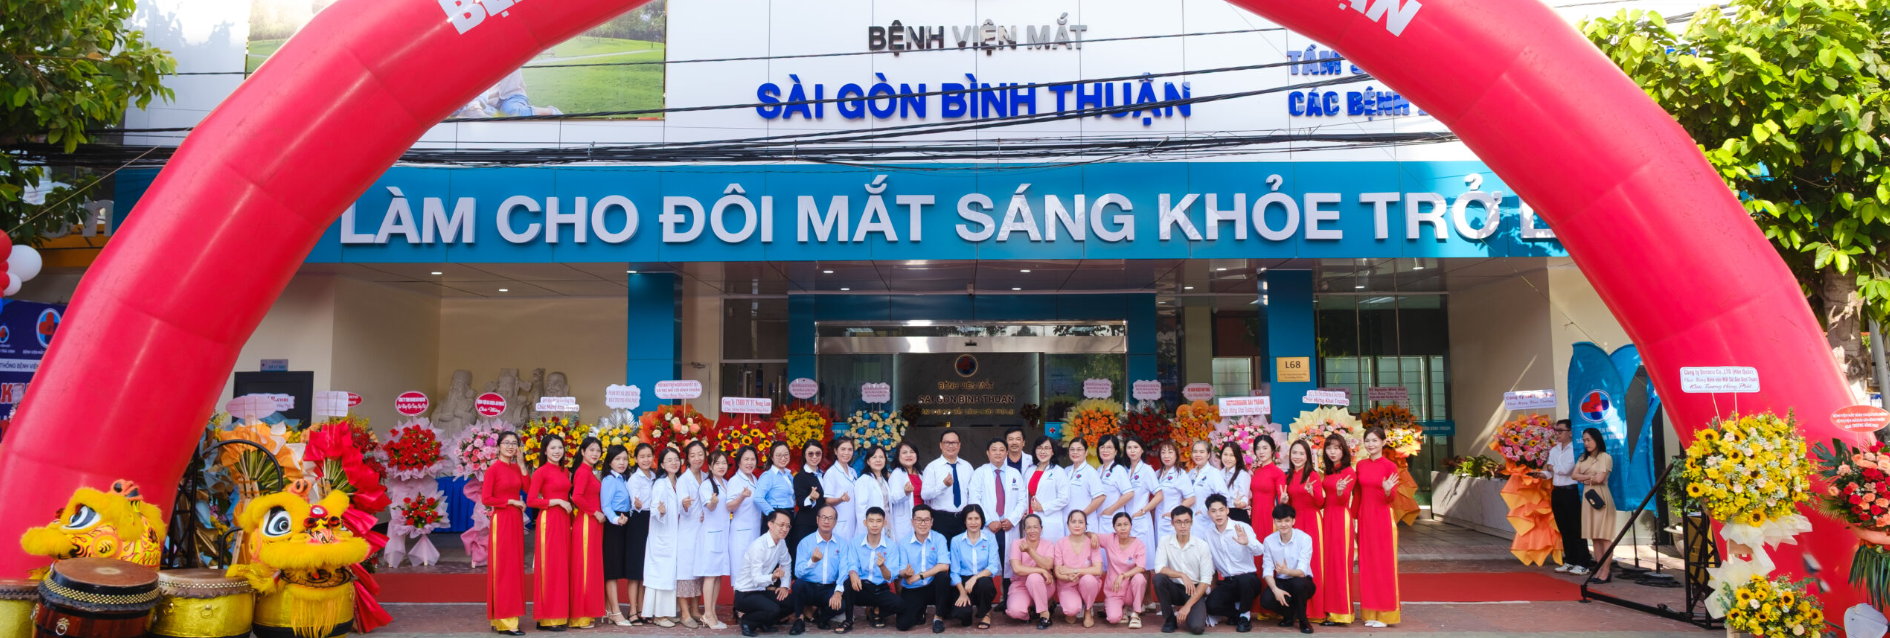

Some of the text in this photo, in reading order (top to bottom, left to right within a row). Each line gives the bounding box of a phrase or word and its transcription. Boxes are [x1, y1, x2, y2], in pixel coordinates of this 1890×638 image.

[868, 12, 1088, 57] BỆNH VIỆN MẮT
[756, 72, 1192, 126] SÀI GÒN BÌNH THUẬN
[1288, 86, 1410, 121] CÁC BỆNH
[340, 186, 476, 244] LÀM
[496, 194, 640, 244] CHO
[658, 183, 774, 243] ĐÔI
[797, 174, 936, 242] MẮT
[955, 183, 1135, 242] SÁNG
[1157, 174, 1343, 241] KHỎE
[1359, 172, 1503, 241] TRỞ
[1285, 360, 1302, 370] L68
